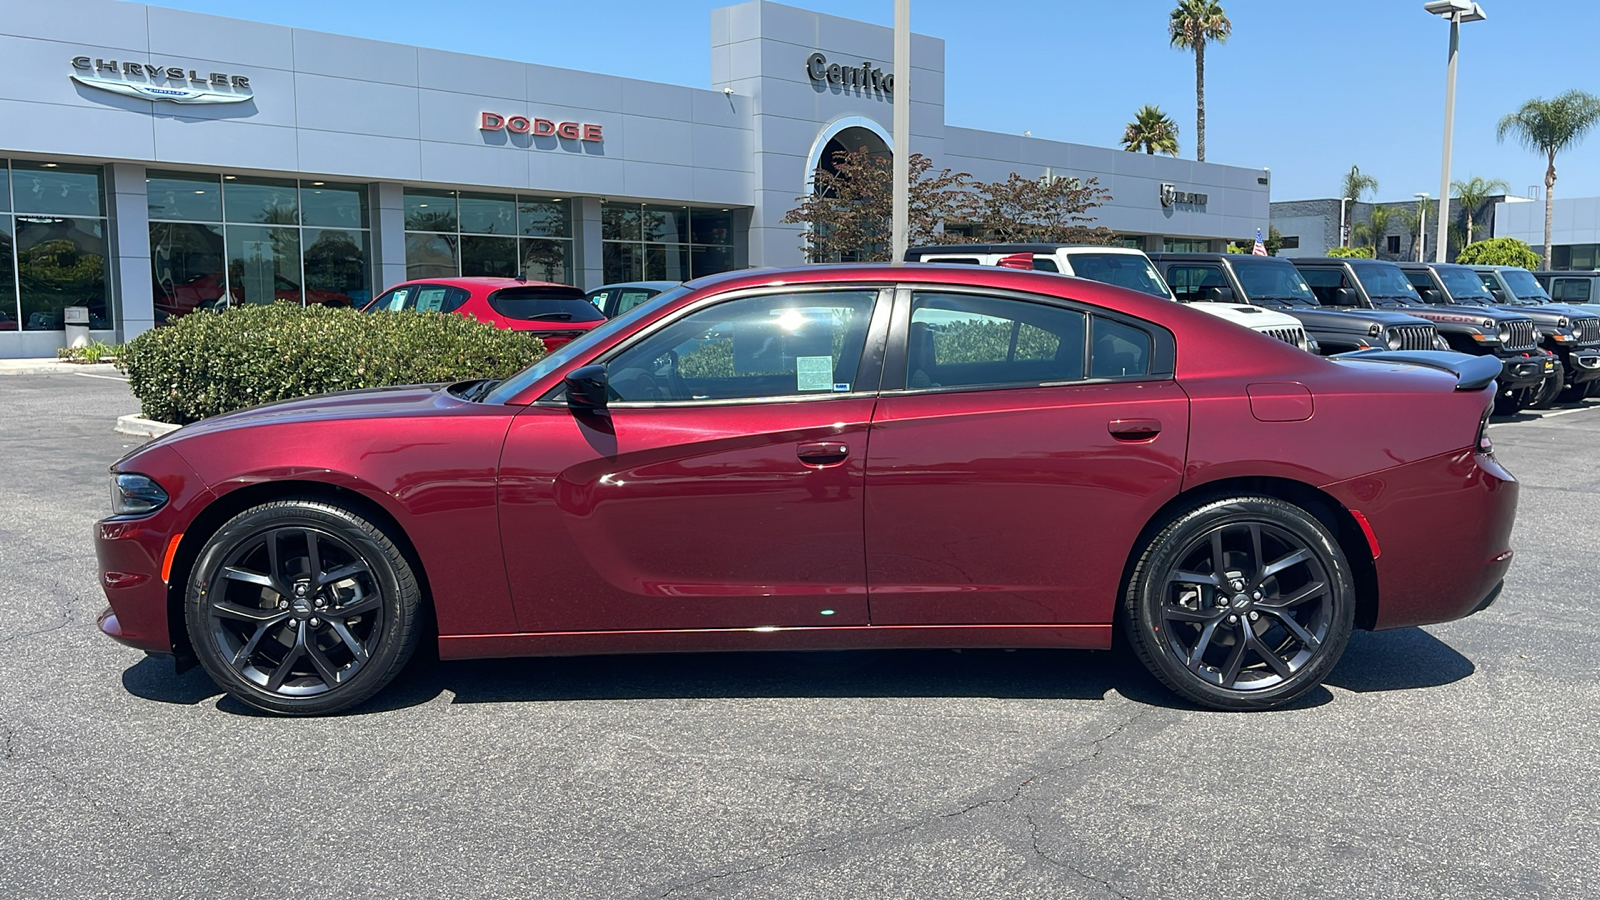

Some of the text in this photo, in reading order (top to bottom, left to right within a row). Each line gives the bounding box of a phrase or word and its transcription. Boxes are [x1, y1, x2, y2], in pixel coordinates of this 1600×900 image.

[71, 56, 250, 88] CHRYSLER
[806, 52, 895, 93] Cerrito
[480, 111, 603, 142] DODGE
[1174, 191, 1208, 205] RAM
[1406, 312, 1478, 323] UBICON
